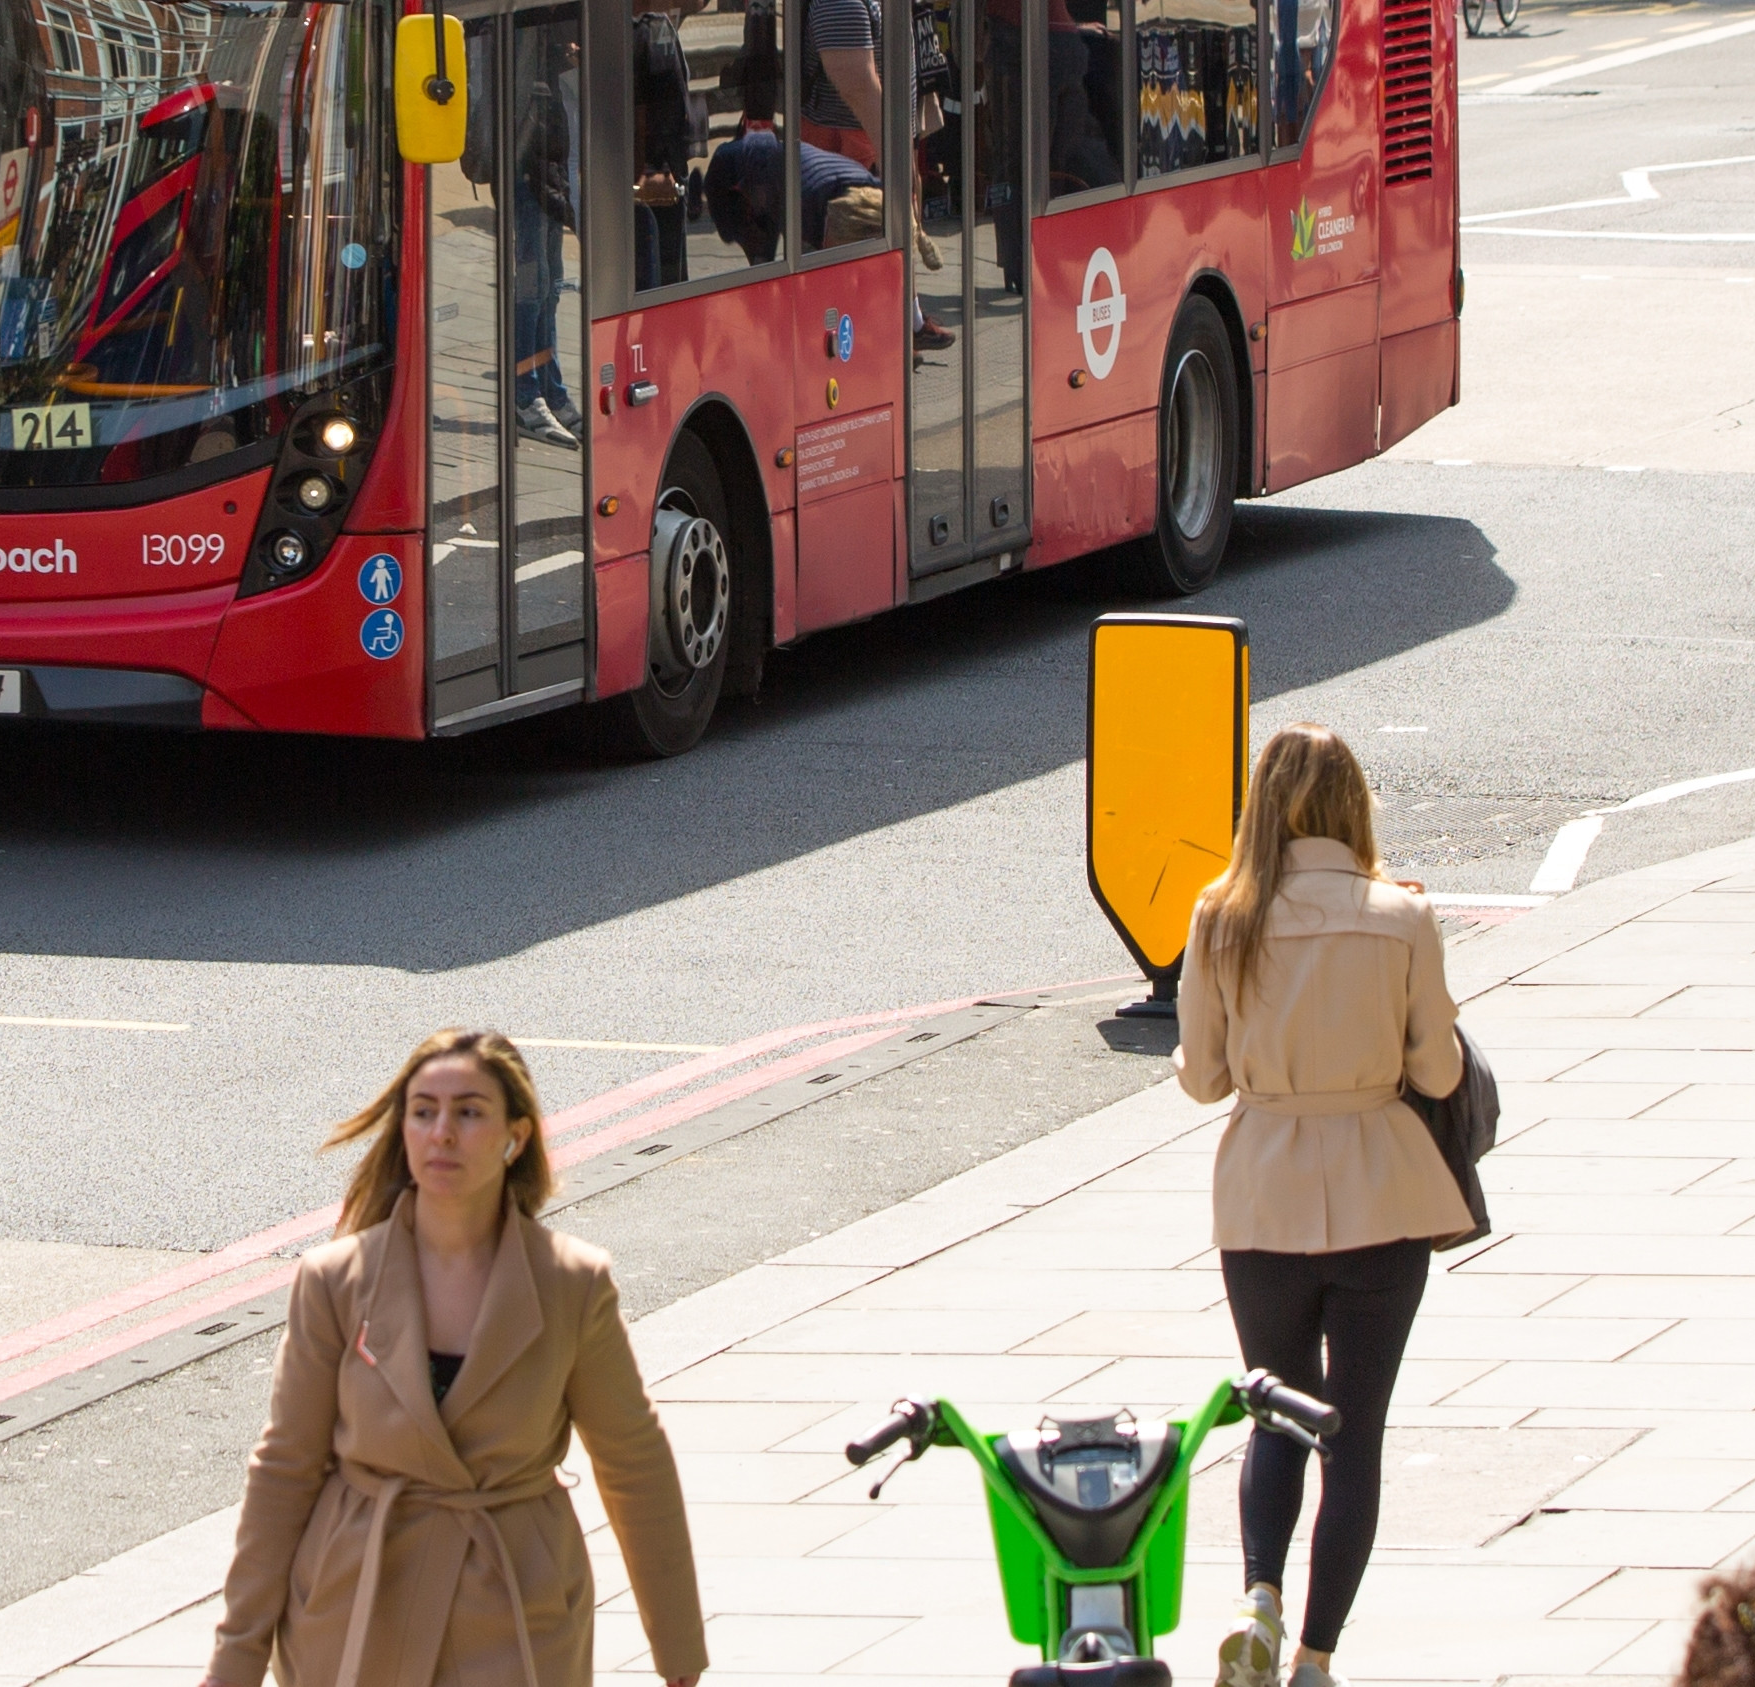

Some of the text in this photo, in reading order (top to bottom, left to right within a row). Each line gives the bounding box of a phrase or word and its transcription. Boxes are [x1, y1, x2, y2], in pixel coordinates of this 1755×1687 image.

[1092, 303, 1112, 324] BUSES
[630, 343, 647, 373] TL
[21, 409, 84, 451] 214
[141, 533, 226, 566] 13099
